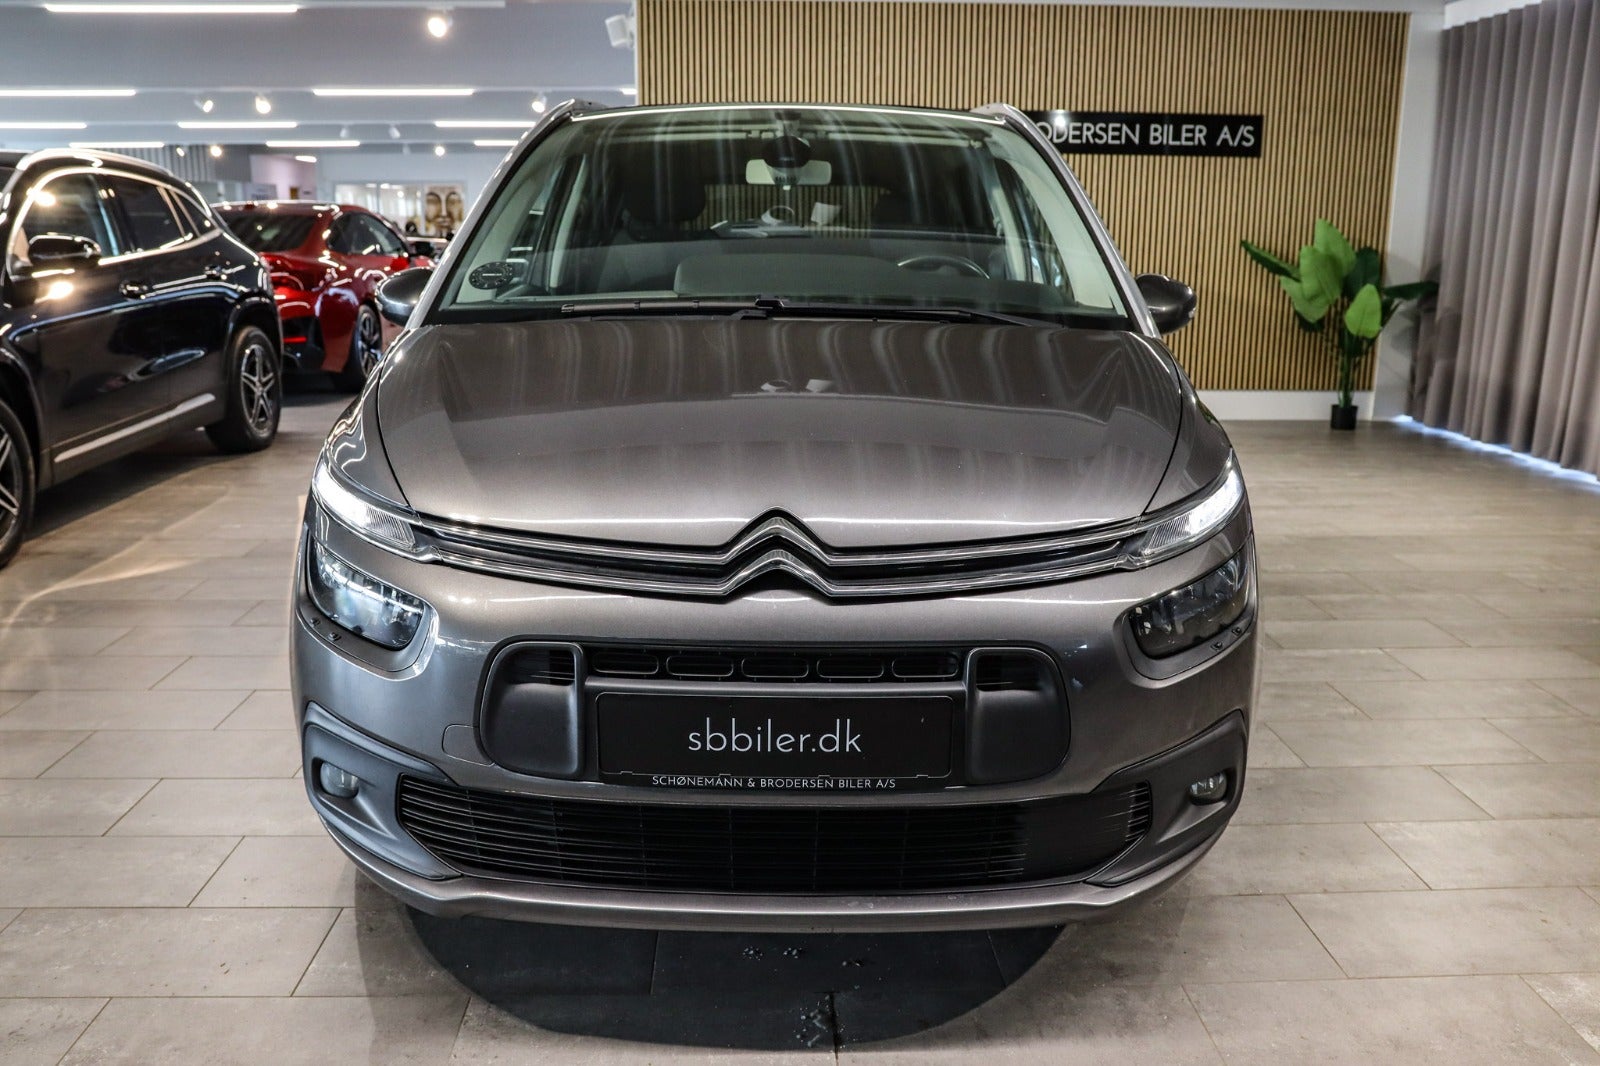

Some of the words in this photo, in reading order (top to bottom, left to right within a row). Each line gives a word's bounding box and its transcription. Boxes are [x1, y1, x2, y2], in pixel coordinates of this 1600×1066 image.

[1149, 124, 1207, 146] BILER
[1216, 125, 1255, 147] A/S
[688, 717, 862, 752] sbbiler.dk
[652, 775, 743, 787] SCHØNEMANN
[747, 778, 756, 788] &
[760, 778, 834, 788] BRODERSEN
[838, 779, 871, 789] BILER
[875, 779, 896, 789] A/S
